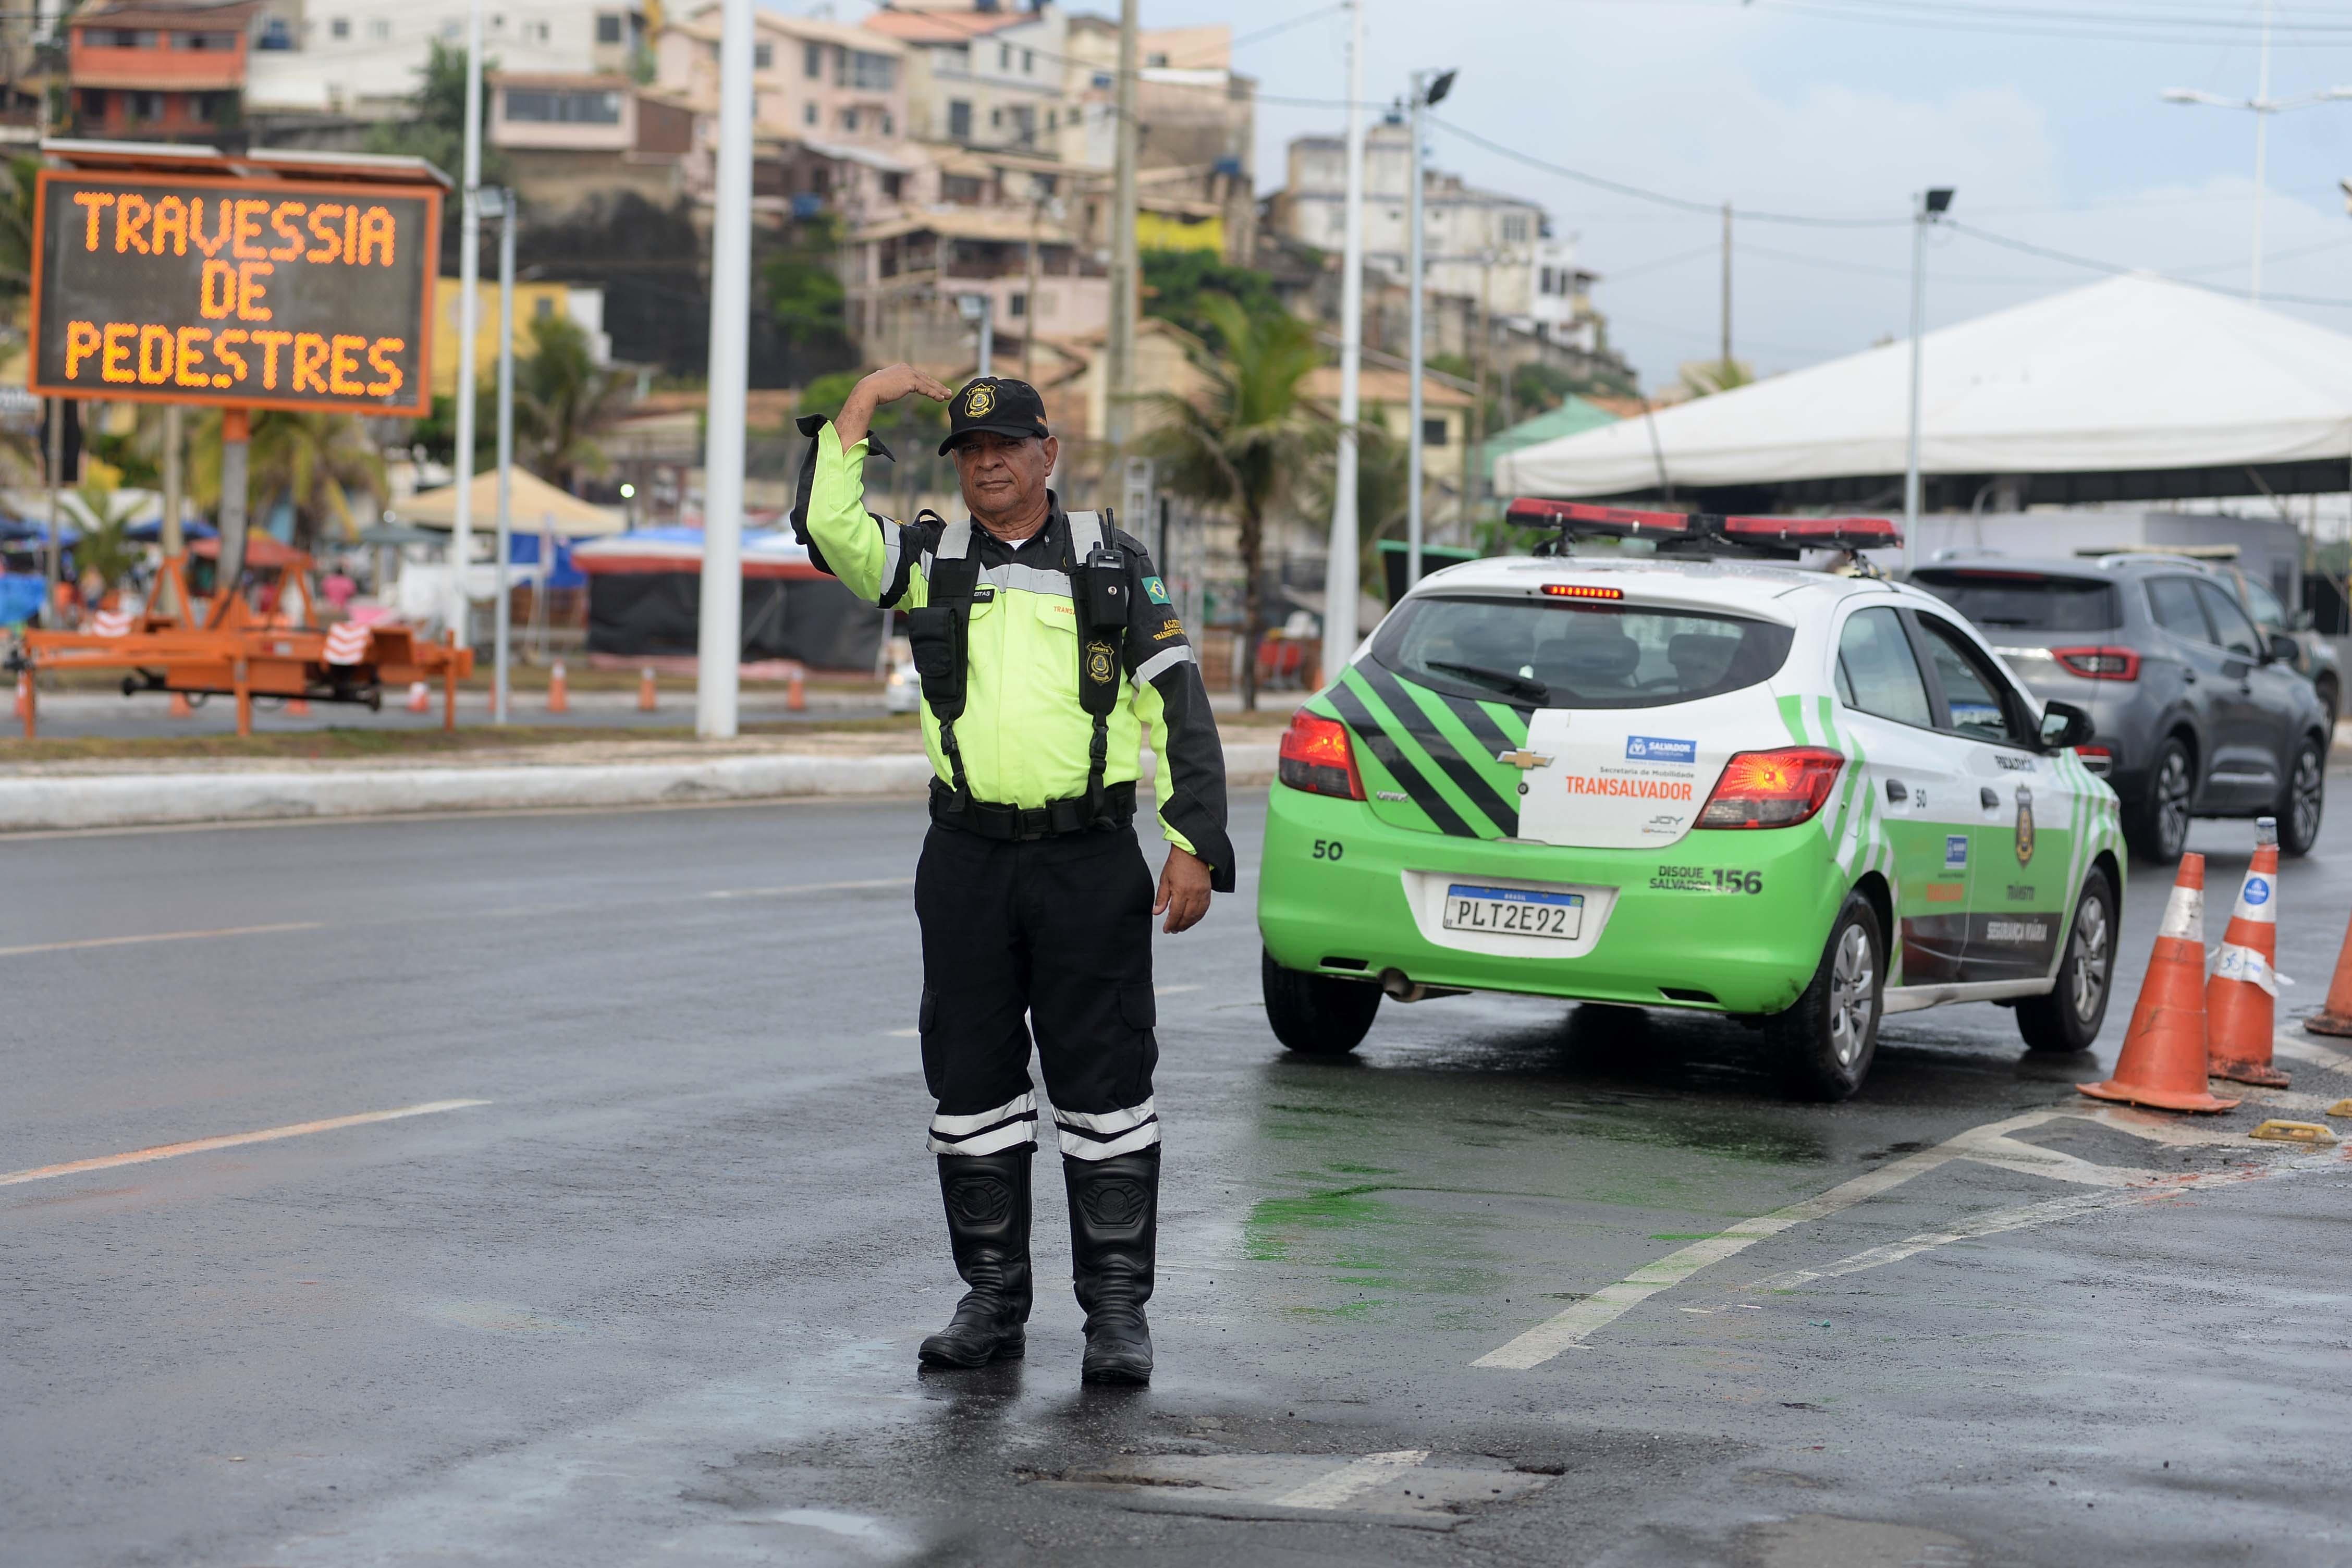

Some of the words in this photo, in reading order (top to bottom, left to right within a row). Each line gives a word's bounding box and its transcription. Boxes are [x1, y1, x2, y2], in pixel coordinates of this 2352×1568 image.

[74, 191, 395, 267] TRAVESSIA
[200, 259, 274, 321] DE
[65, 320, 405, 397] PEDESTRES
[1649, 742, 1690, 752] SALVADOR
[1600, 766, 1638, 775] Secretaria
[1652, 770, 1695, 778] Mobilidade
[1566, 776, 1693, 801] TRANSALVADOR
[1916, 789, 1927, 808] 50
[1649, 815, 1684, 825] JOY
[1313, 839, 1343, 861] 50
[1659, 865, 1704, 878] DISQUE
[1712, 868, 1762, 895] 156
[1649, 878, 1711, 892] SALVADOR
[1504, 893, 1526, 901] BRASIL
[1457, 901, 1566, 934] PLT2E92
